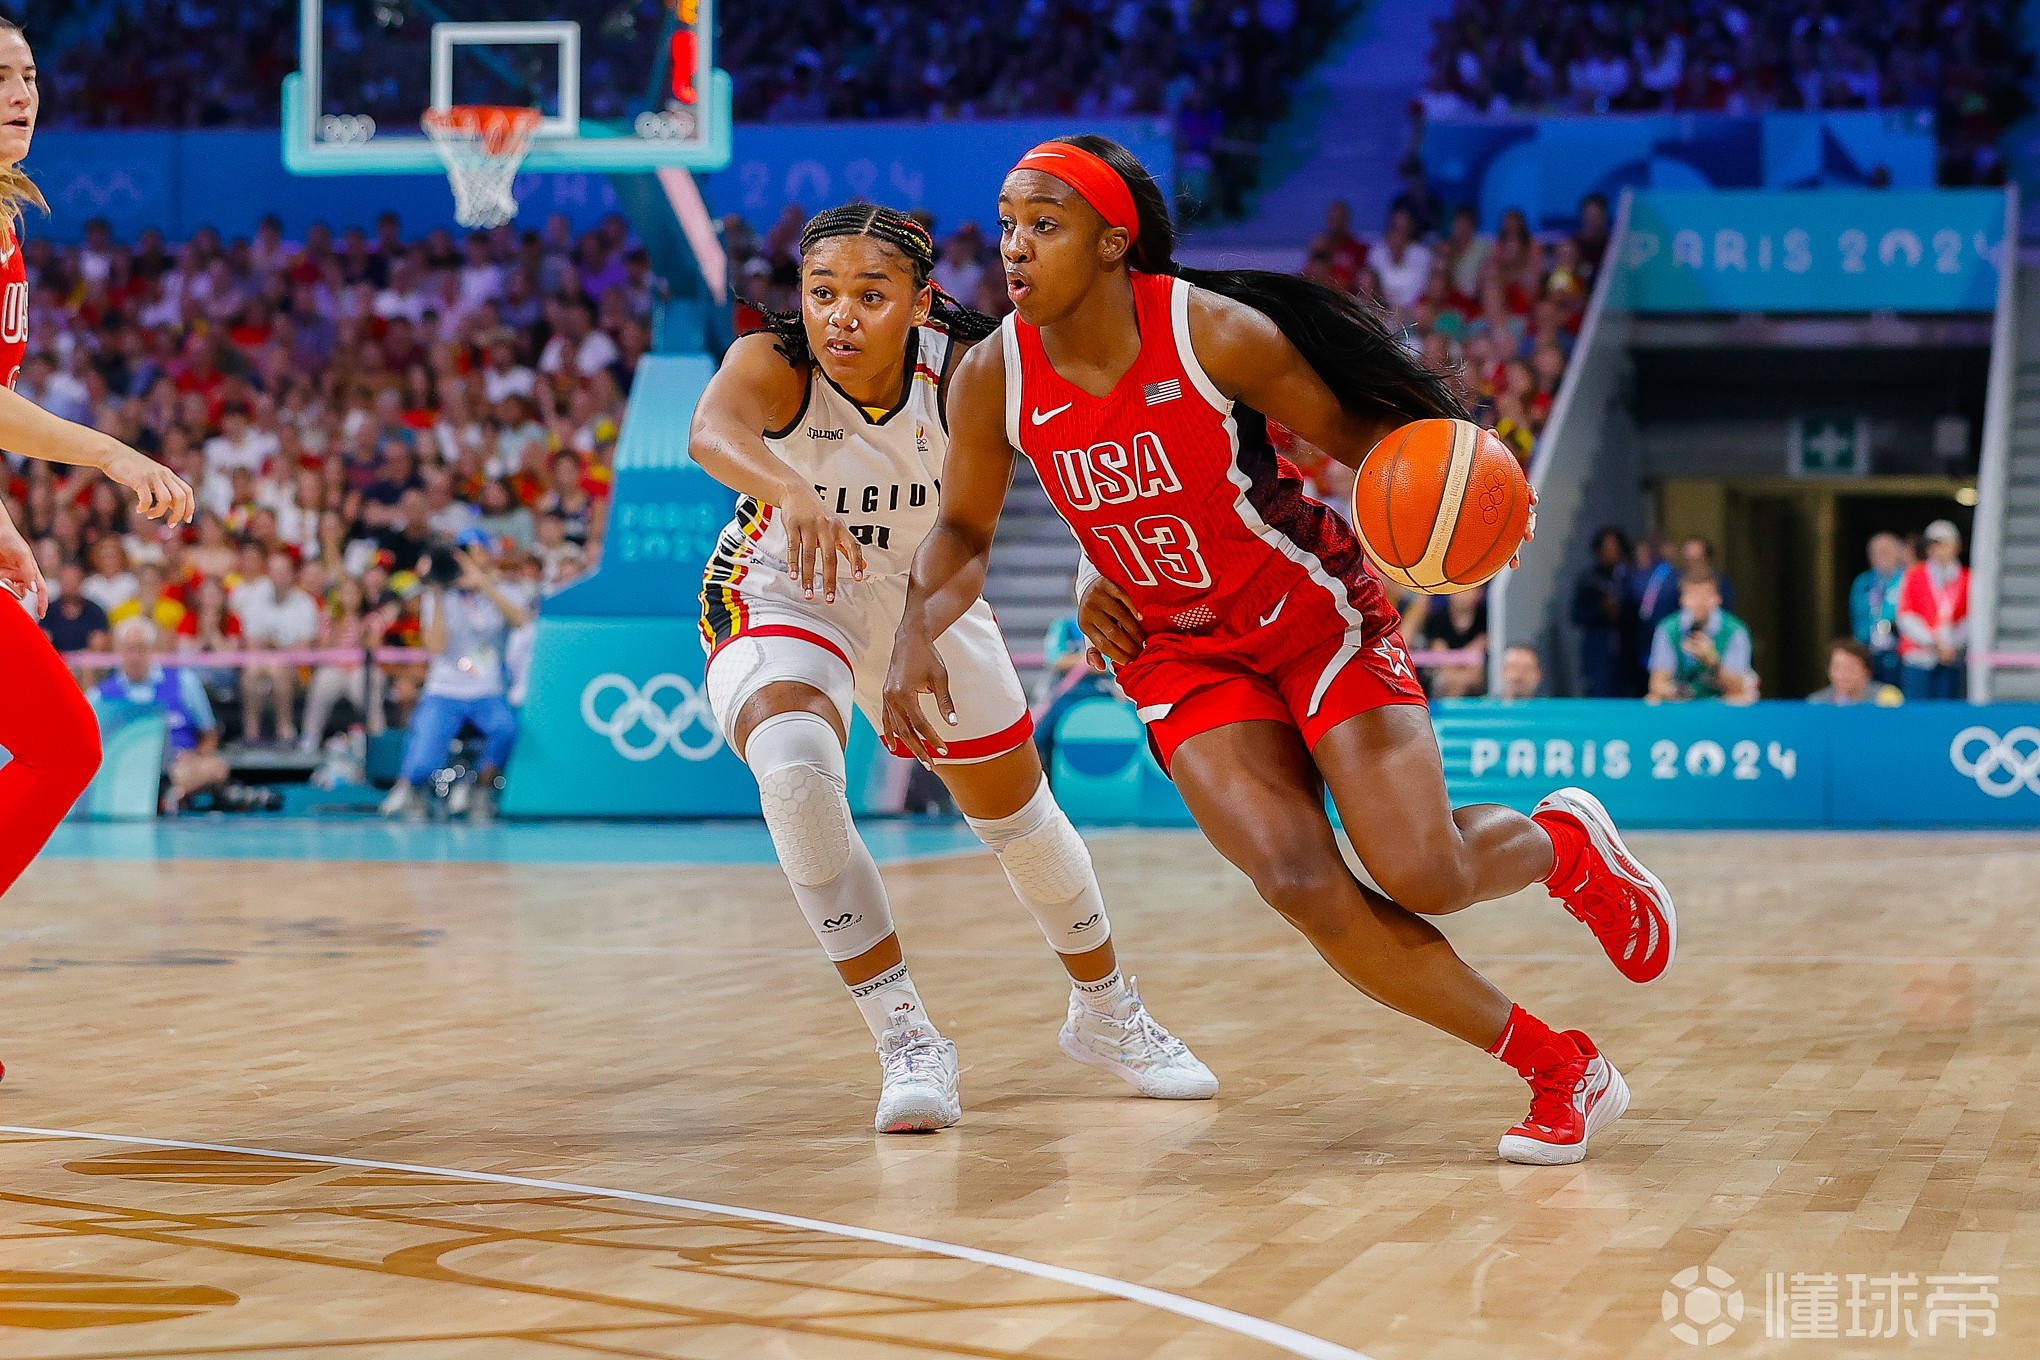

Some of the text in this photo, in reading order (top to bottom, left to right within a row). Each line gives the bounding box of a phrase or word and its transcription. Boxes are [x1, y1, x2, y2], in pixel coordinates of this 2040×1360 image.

[1623, 229, 1812, 273] PARIS
[1052, 431, 1183, 511] USA
[814, 479, 941, 514] ELGIU
[1090, 514, 1212, 588] 13
[1470, 739, 1797, 780] PARIS 2024
[852, 965, 907, 998] SPALDIN
